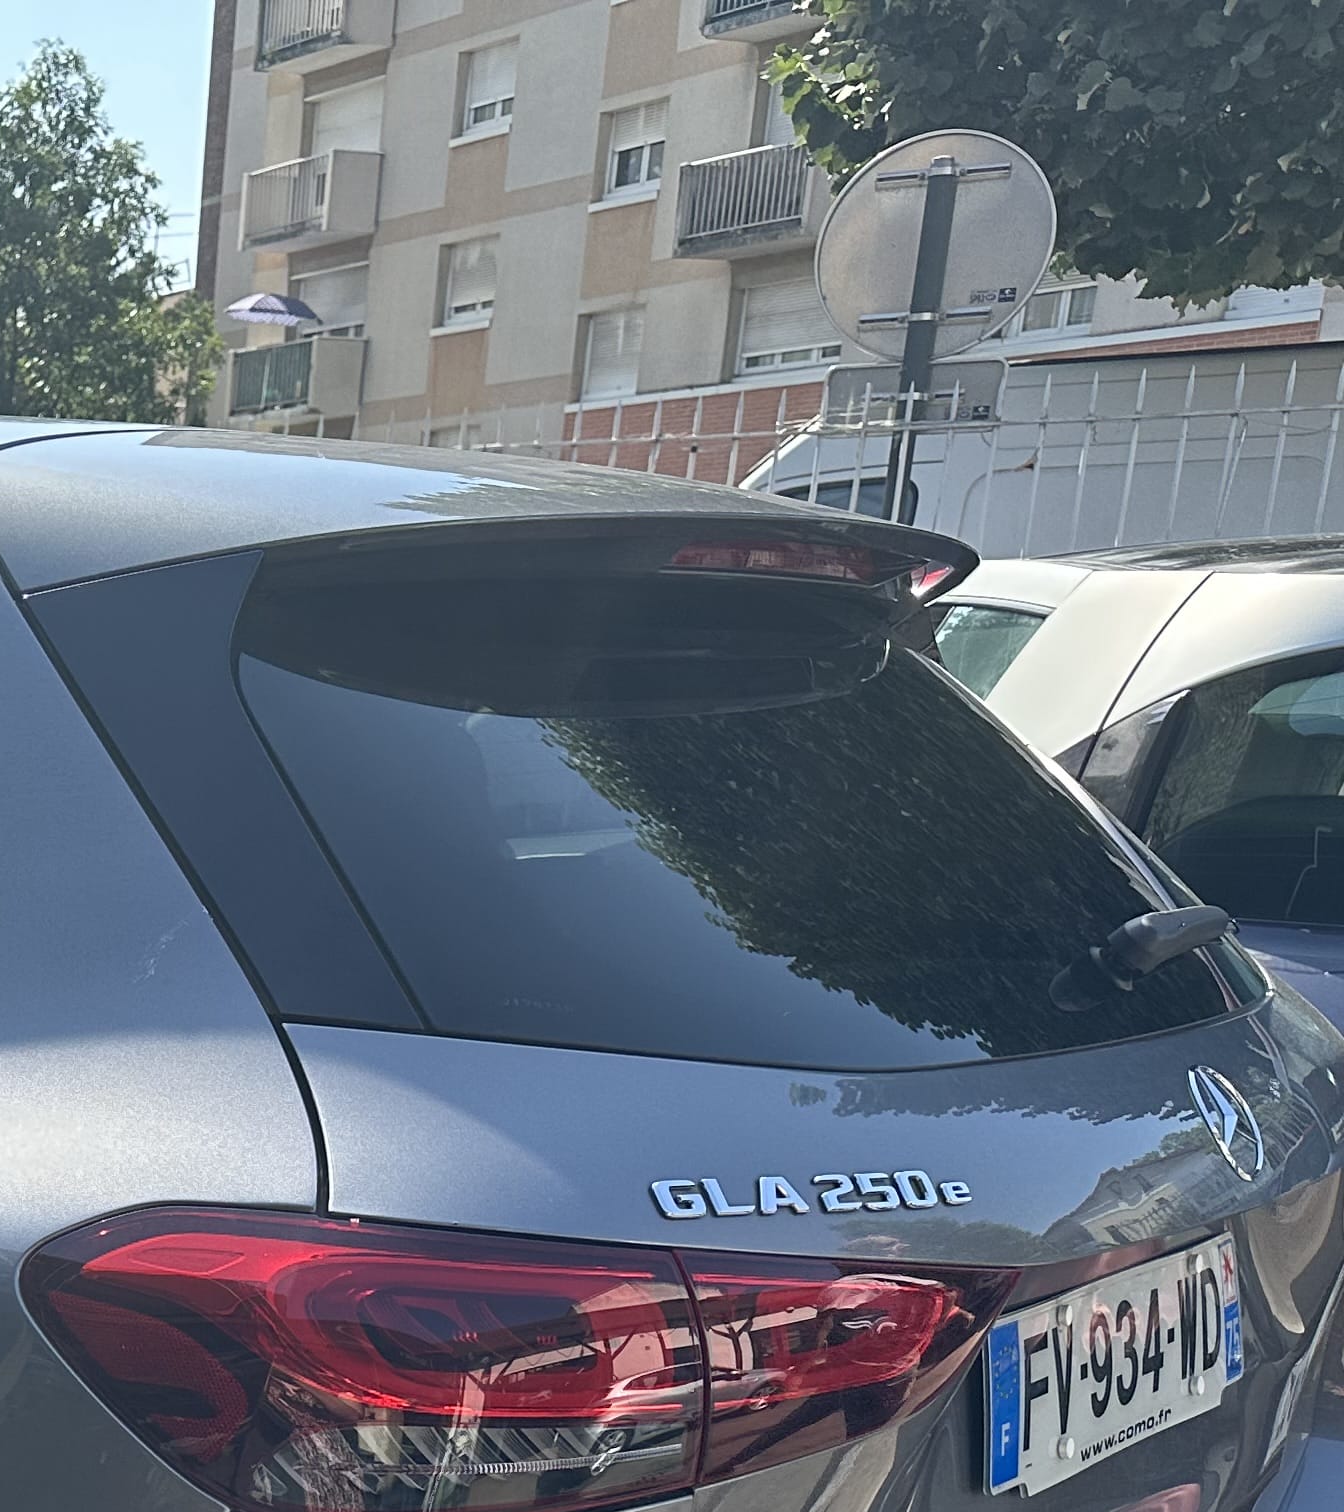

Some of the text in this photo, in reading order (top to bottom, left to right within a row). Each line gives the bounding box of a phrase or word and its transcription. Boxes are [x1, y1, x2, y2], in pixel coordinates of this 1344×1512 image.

[651, 1174, 810, 1220] GLA
[1023, 1267, 1222, 1452] FV-934-WD
[1225, 1319, 1241, 1366] 75
[1001, 1422, 1011, 1457] F
[1080, 1408, 1172, 1462] www.como.fr
